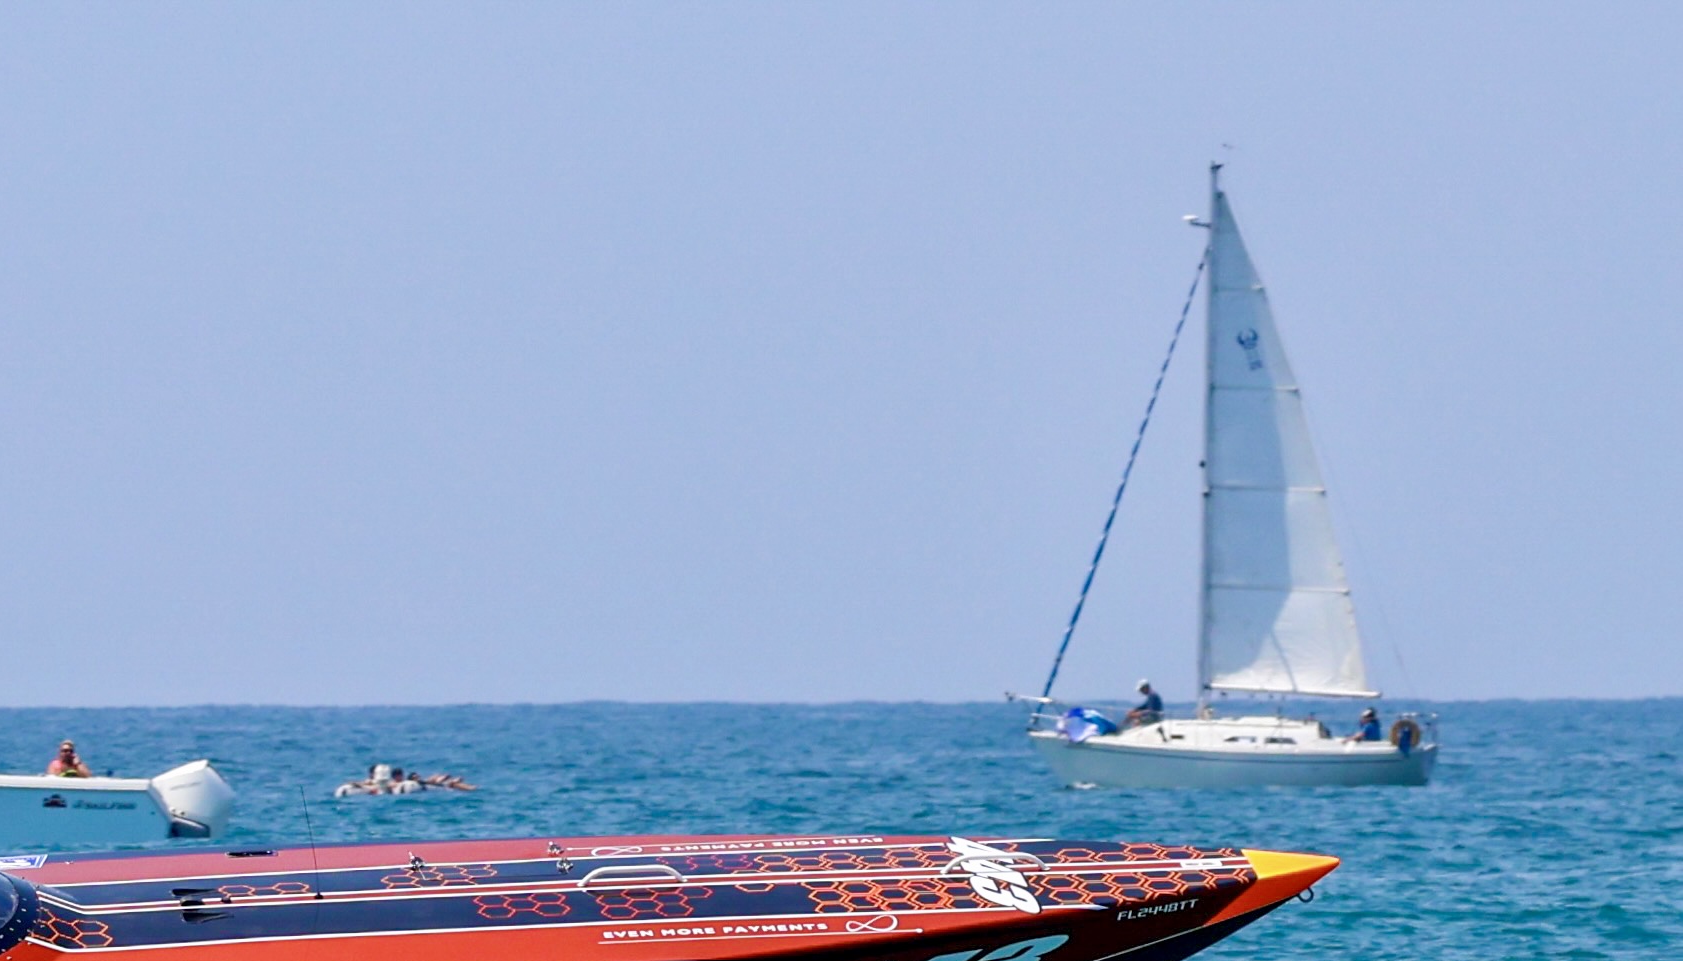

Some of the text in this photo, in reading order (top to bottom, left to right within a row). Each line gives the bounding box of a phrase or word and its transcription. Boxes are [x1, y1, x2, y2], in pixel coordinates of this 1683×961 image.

[661, 843, 765, 851] PAYMENTS
[603, 922, 828, 939] EVEN MORE PAYMENTS
